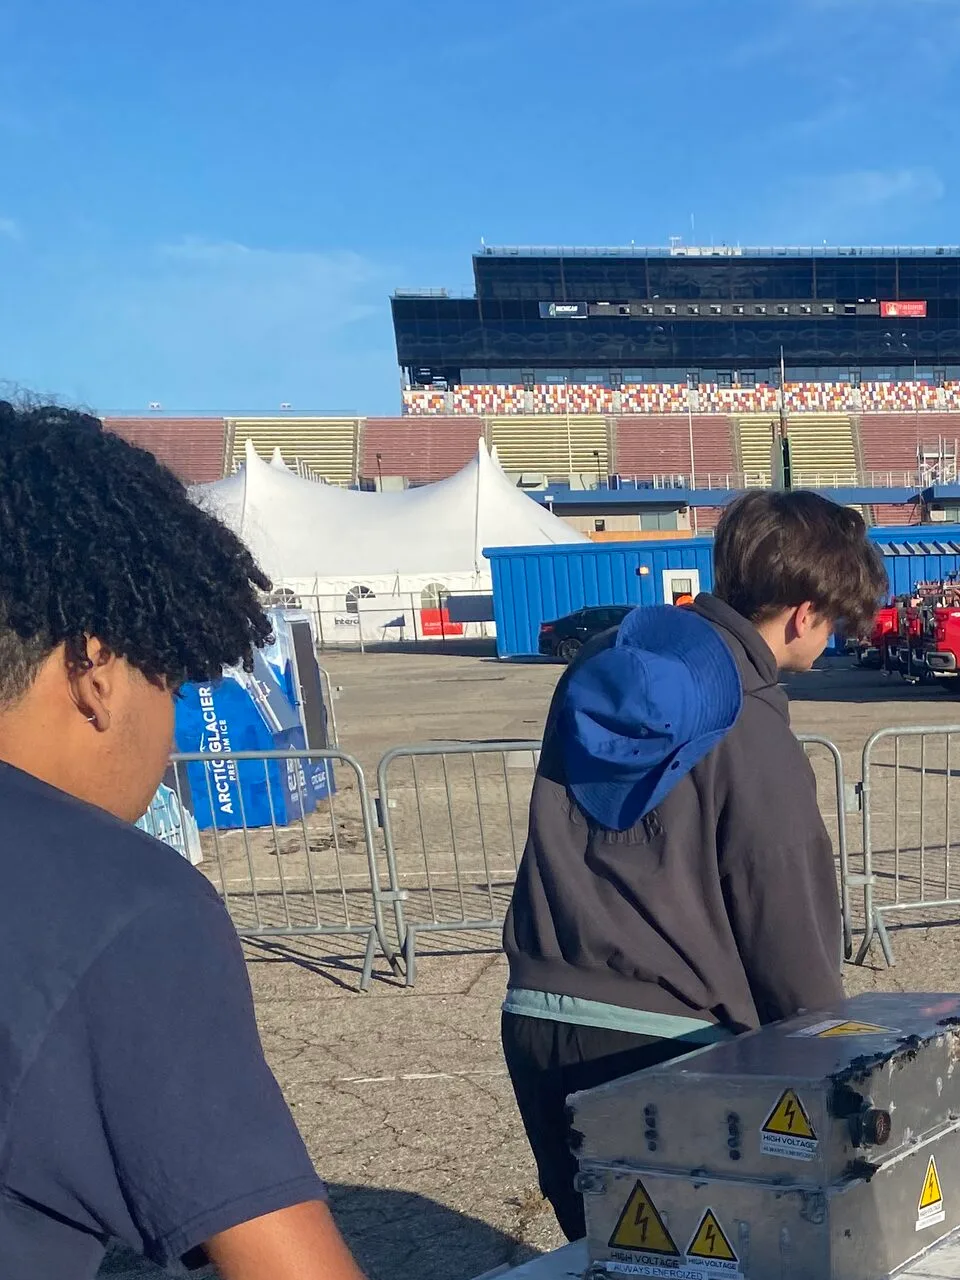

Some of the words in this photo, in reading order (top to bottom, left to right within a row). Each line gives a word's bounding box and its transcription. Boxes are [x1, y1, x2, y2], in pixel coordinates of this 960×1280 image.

[199, 686, 222, 753] GLACIER
[219, 719, 229, 735] ICE
[212, 759, 233, 814] ARCTIC
[763, 1134, 781, 1143] HIGH
[782, 1137, 815, 1149] VOLTAGE
[611, 1251, 633, 1262] HIGH
[636, 1254, 680, 1269] VOLTAGE
[704, 1260, 737, 1270] VOLTAGE
[613, 1263, 651, 1275] ALWAYS
[652, 1267, 704, 1280] ENERGIZED
